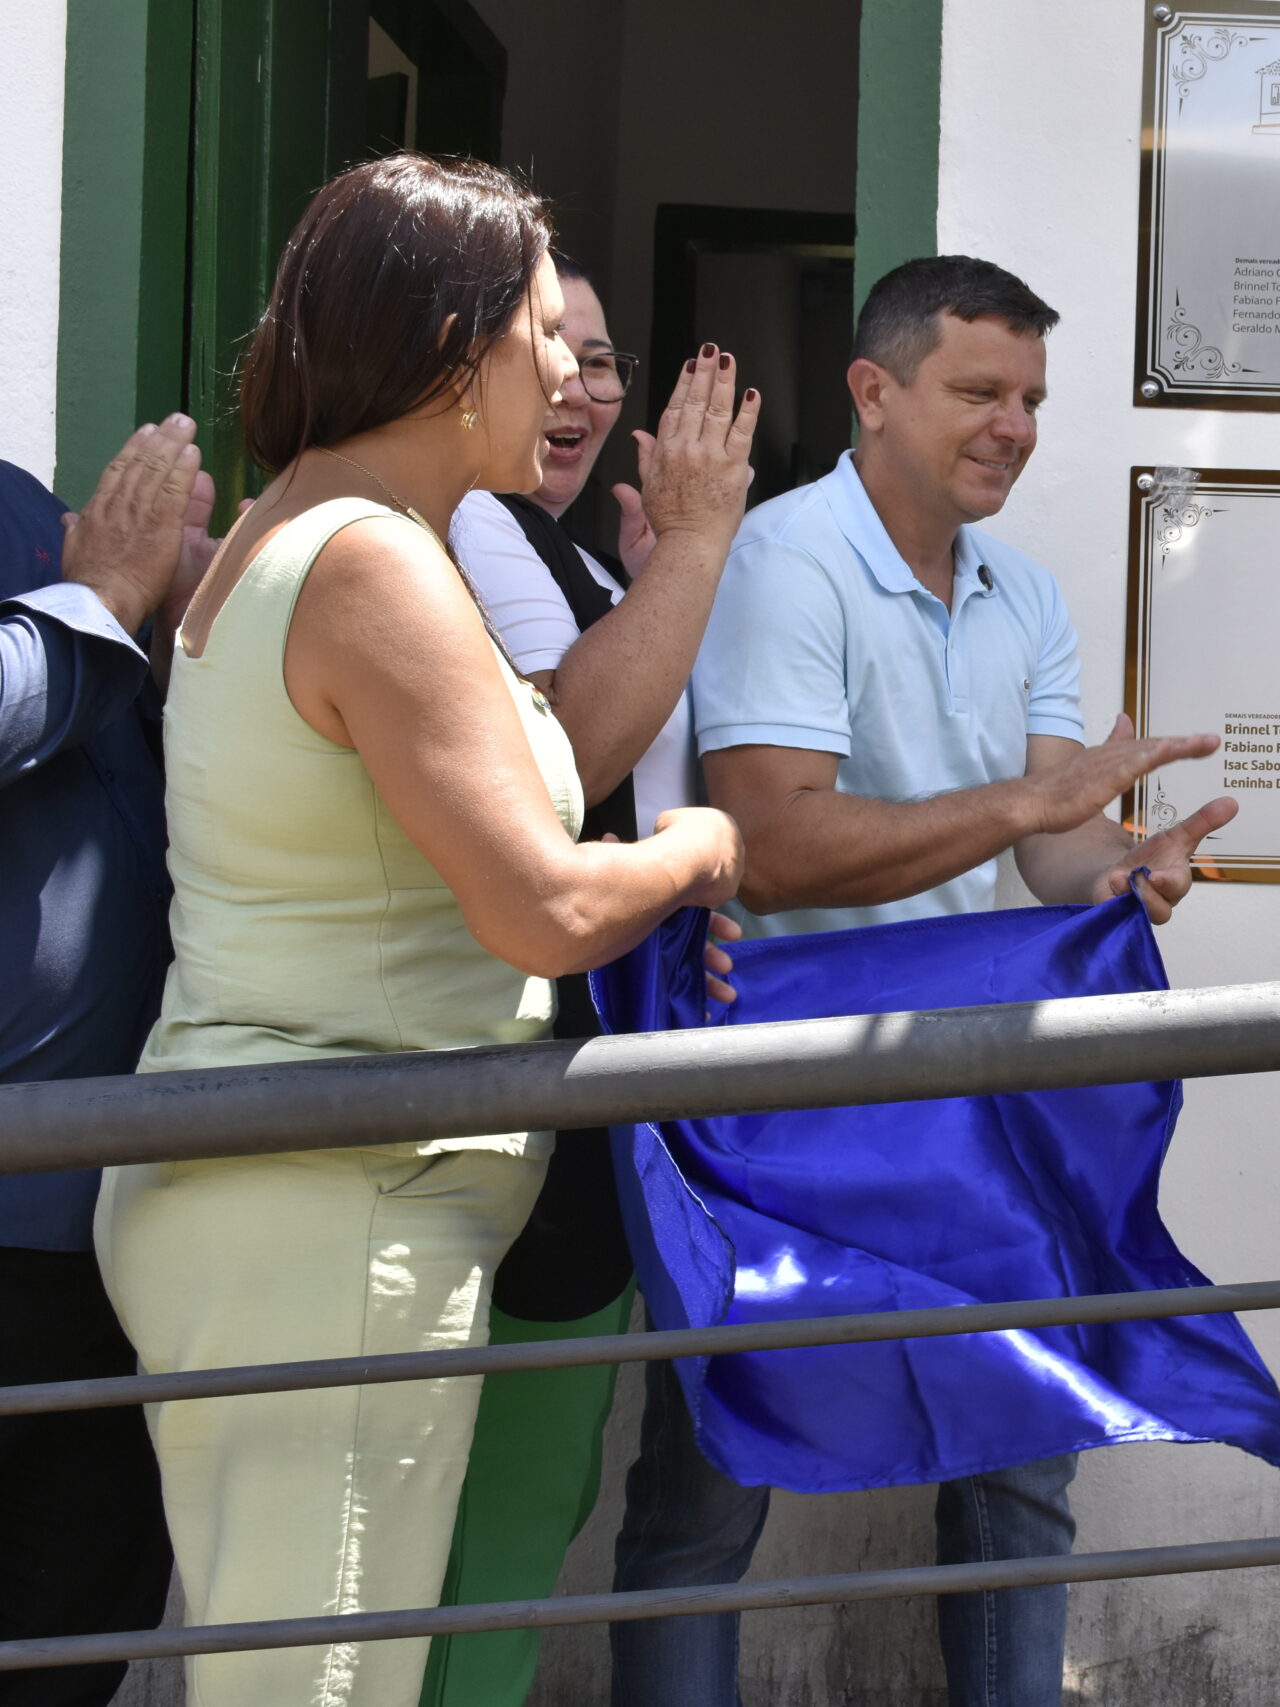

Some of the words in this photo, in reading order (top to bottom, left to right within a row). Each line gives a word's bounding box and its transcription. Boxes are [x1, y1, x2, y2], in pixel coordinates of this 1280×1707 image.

[1234, 266, 1274, 277] Adriano
[1233, 280, 1268, 291] Brinnel
[1233, 295, 1273, 306] Fabiano
[1233, 309, 1280, 320] Fernando
[1232, 323, 1272, 334] Geraldo
[1225, 724, 1269, 735] Brinnel
[1224, 742, 1273, 753] Fabiano
[1224, 760, 1247, 771] Isac
[1223, 778, 1273, 789] Leninha
